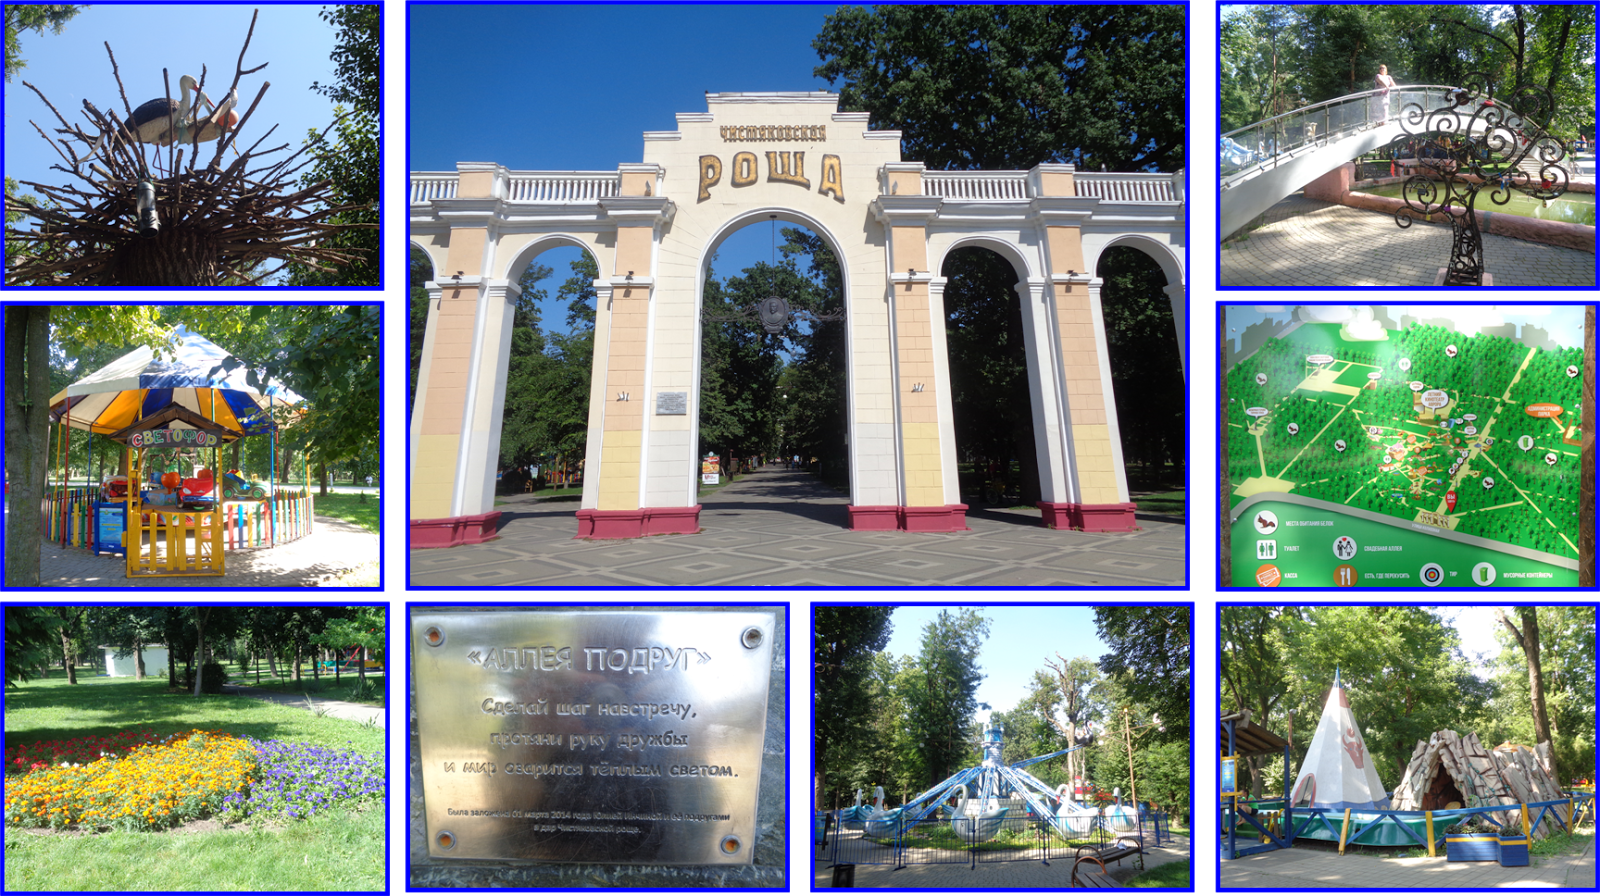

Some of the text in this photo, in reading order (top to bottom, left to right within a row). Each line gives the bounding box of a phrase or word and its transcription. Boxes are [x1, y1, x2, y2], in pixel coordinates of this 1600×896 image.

[720, 125, 827, 142] ЧИСТЯКОВСКАЯ
[697, 151, 845, 204] РОЩА
[132, 429, 217, 446] СВЕТОФОР
[467, 646, 712, 675] «АЛЛЕЯ ПОДРУГ»
[481, 697, 697, 721] Сделай шаг навстречу,
[490, 730, 688, 751] протяни руку дружбы
[443, 761, 739, 779] и мир озарится тёплым светом.
[447, 808, 469, 816] Была
[470, 809, 510, 818] заложена
[511, 810, 523, 818] 01
[524, 811, 549, 820] марта
[550, 811, 571, 819] 2014
[572, 811, 592, 820] года
[671, 813, 683, 821] её
[684, 813, 730, 822] подругами
[615, 825, 641, 834] роще.
